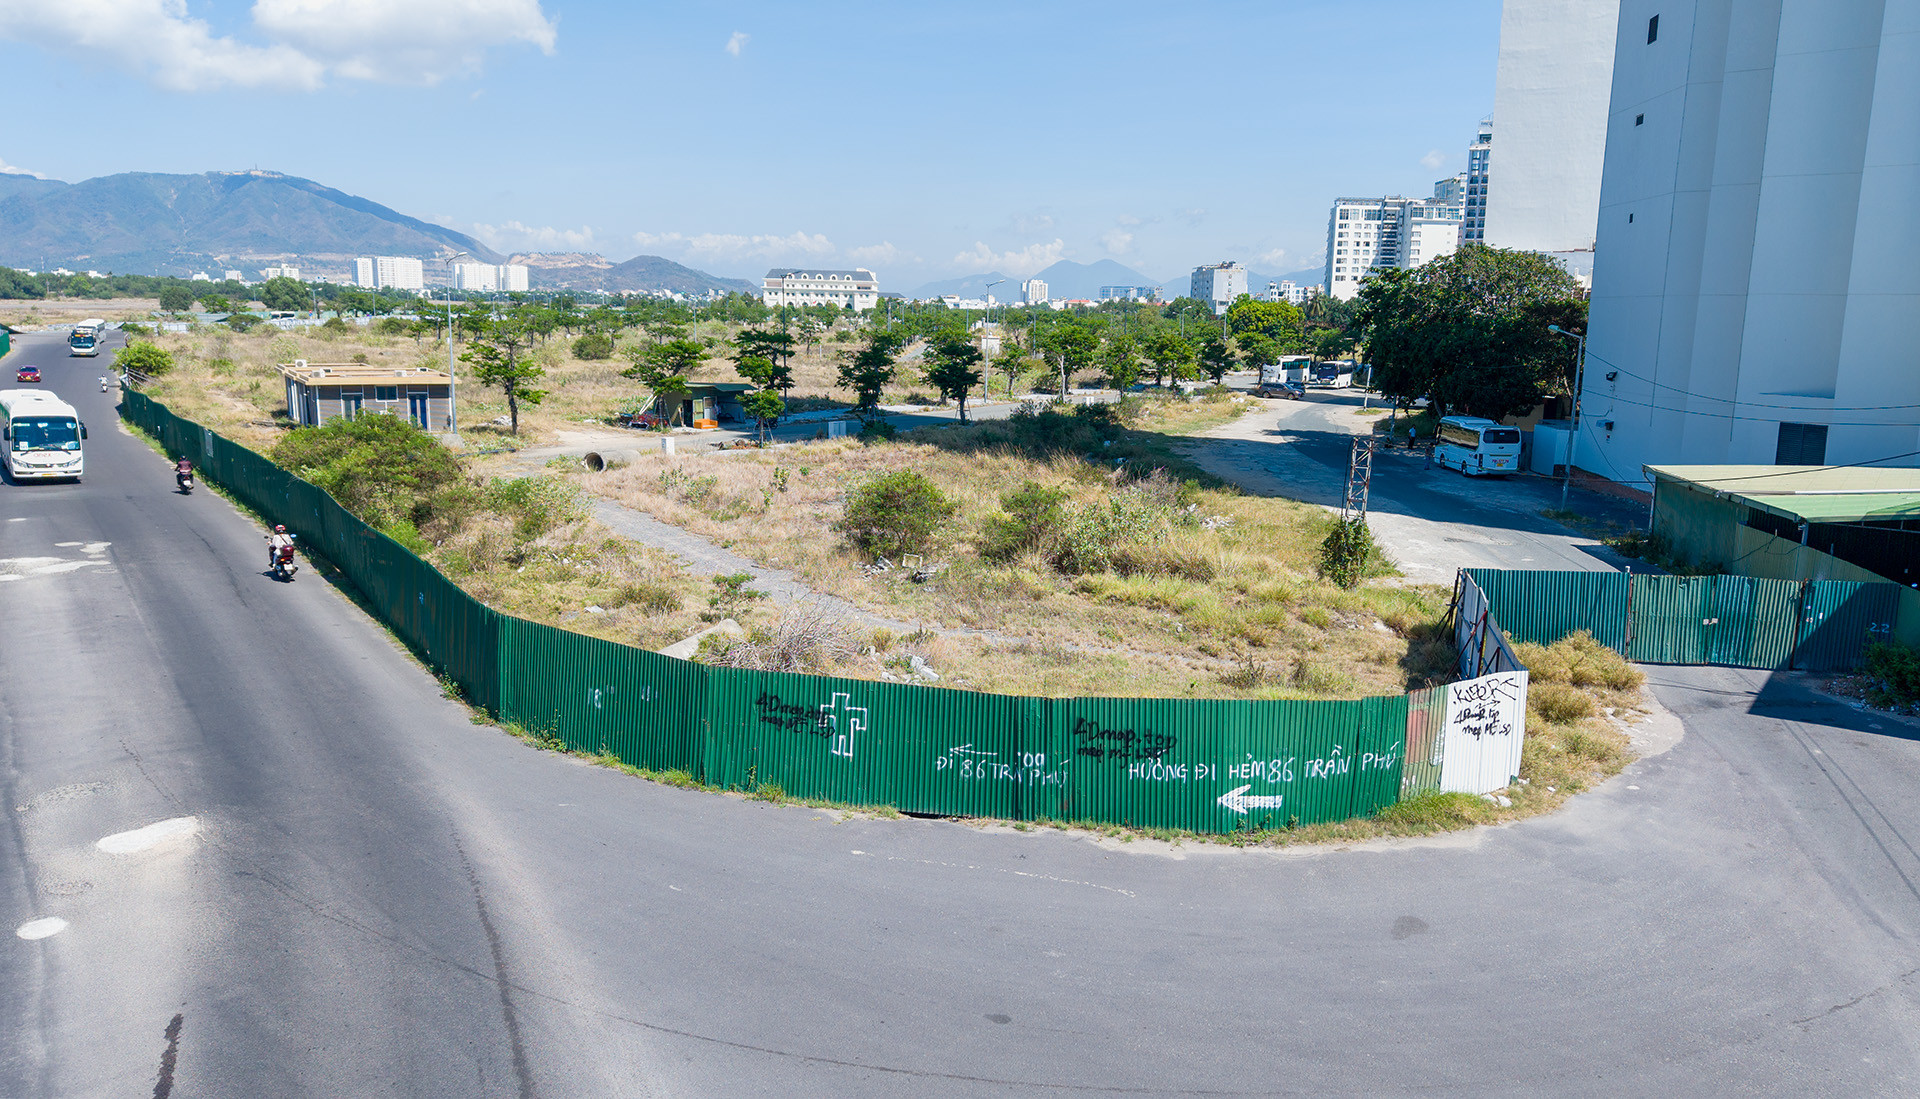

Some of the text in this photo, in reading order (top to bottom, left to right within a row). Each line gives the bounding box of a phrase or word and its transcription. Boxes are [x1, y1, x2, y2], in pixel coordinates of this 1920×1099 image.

[1870, 622, 1890, 634] 22
[960, 760, 986, 780] 86
[1195, 763, 1216, 781] ĐI
[1268, 757, 1295, 783] 86
[1304, 744, 1352, 779] TRẦN
